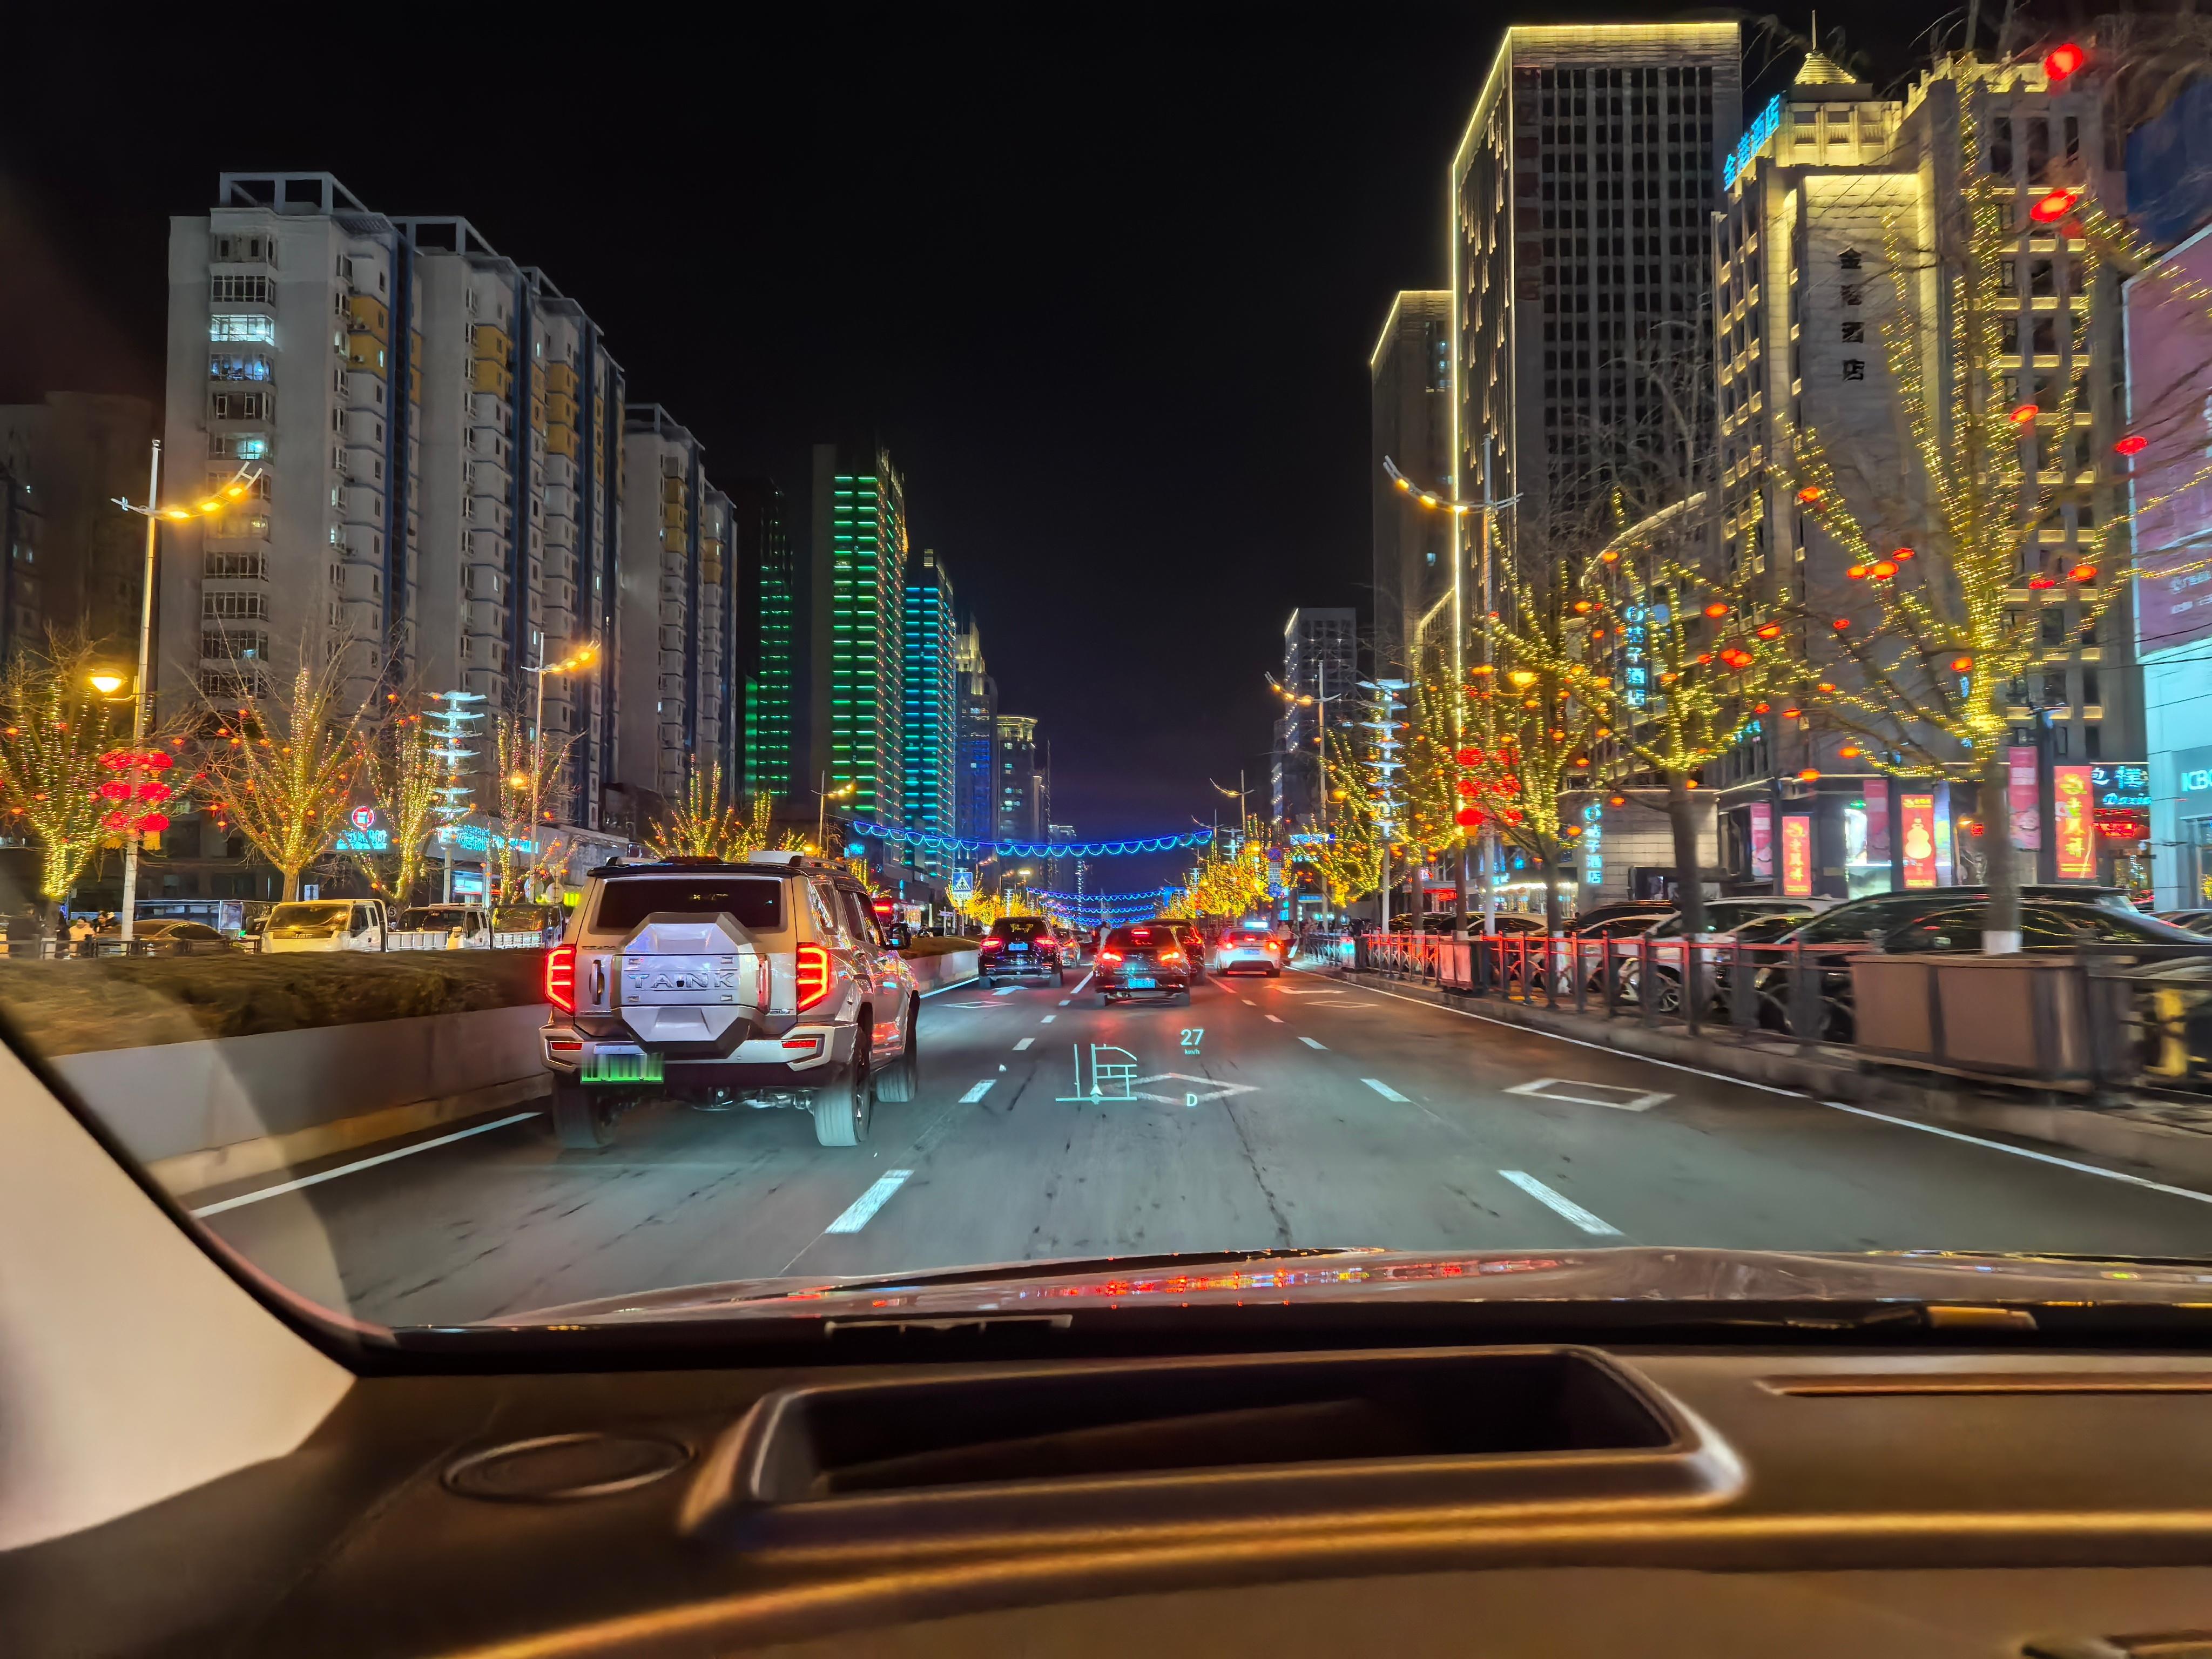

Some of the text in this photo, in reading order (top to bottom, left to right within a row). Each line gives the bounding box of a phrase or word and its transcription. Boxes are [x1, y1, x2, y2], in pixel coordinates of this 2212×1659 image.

[628, 973, 734, 988] TANK
[1181, 1029, 1205, 1046] 27
[1186, 1093, 1198, 1107] D
